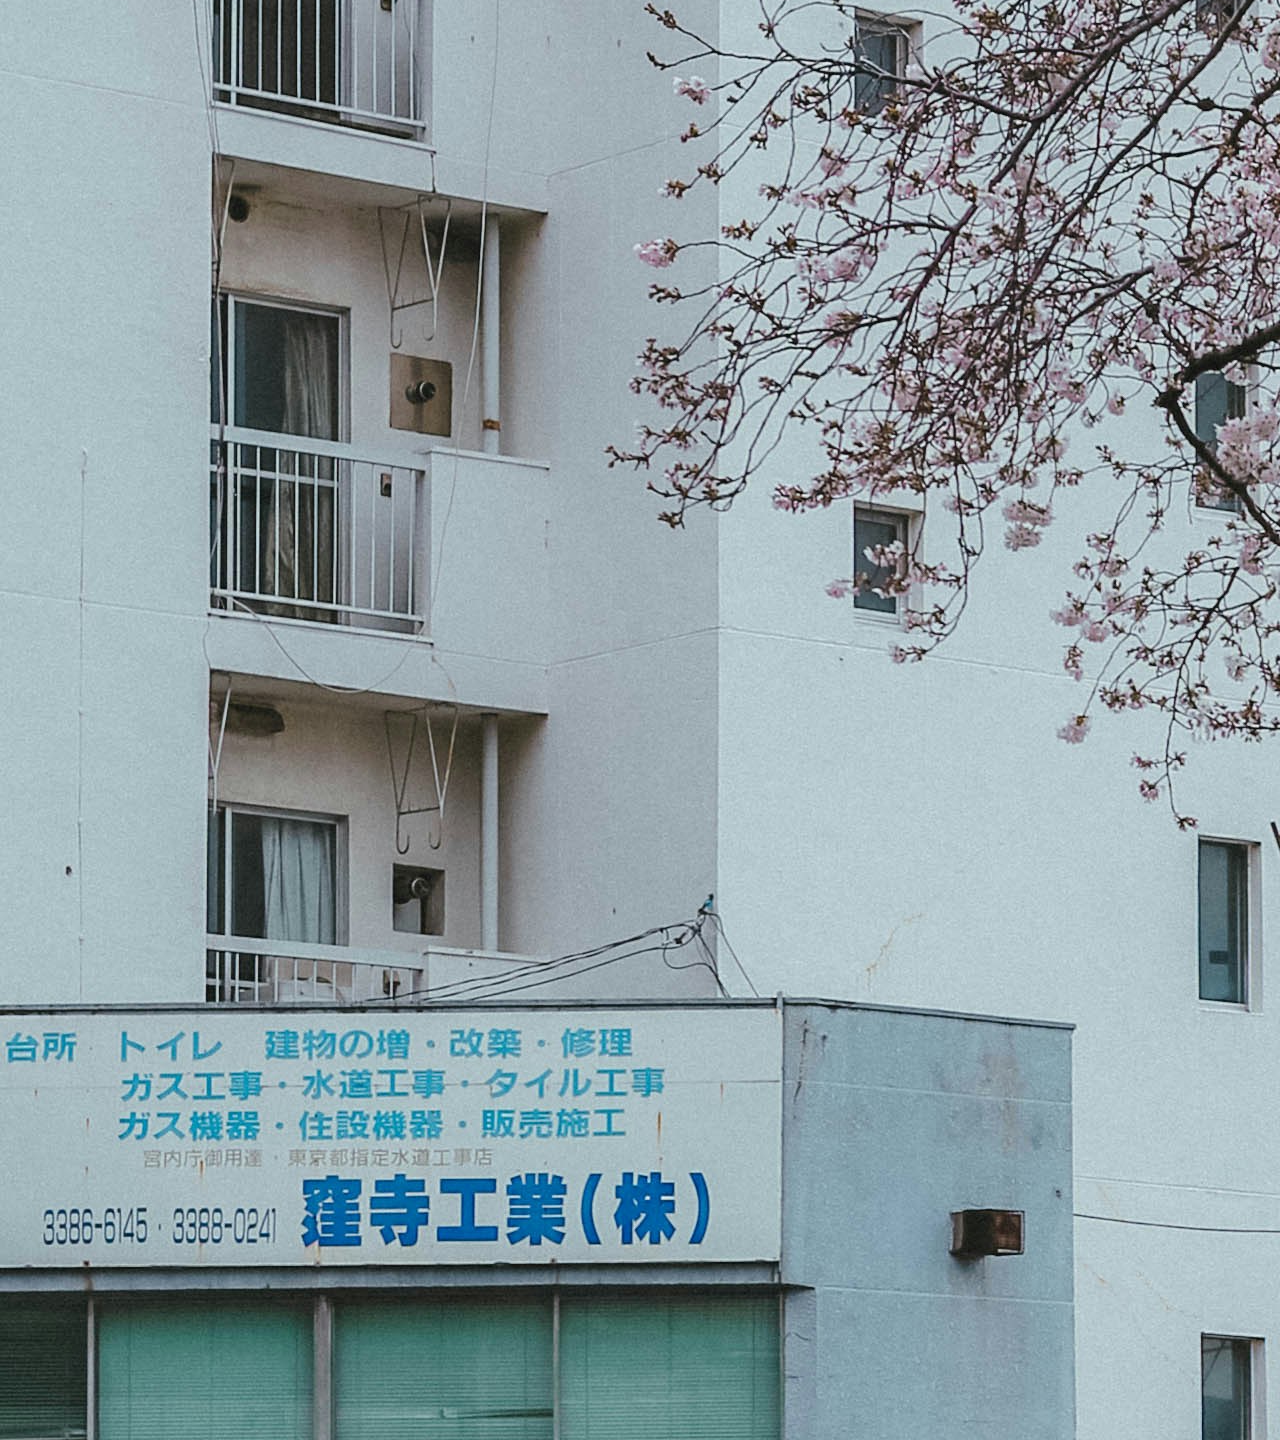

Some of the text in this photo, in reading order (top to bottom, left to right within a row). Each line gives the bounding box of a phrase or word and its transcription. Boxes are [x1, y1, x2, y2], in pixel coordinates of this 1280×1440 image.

[5, 1028, 633, 1062] 台所 トイレ 建物の増・改築・修理
[121, 1067, 665, 1102] ガス工事・水道工事・タイル工事
[118, 1108, 627, 1141] ガス機器・住設機器・販売施工
[301, 1172, 711, 1247] 窪寺工業(株)
